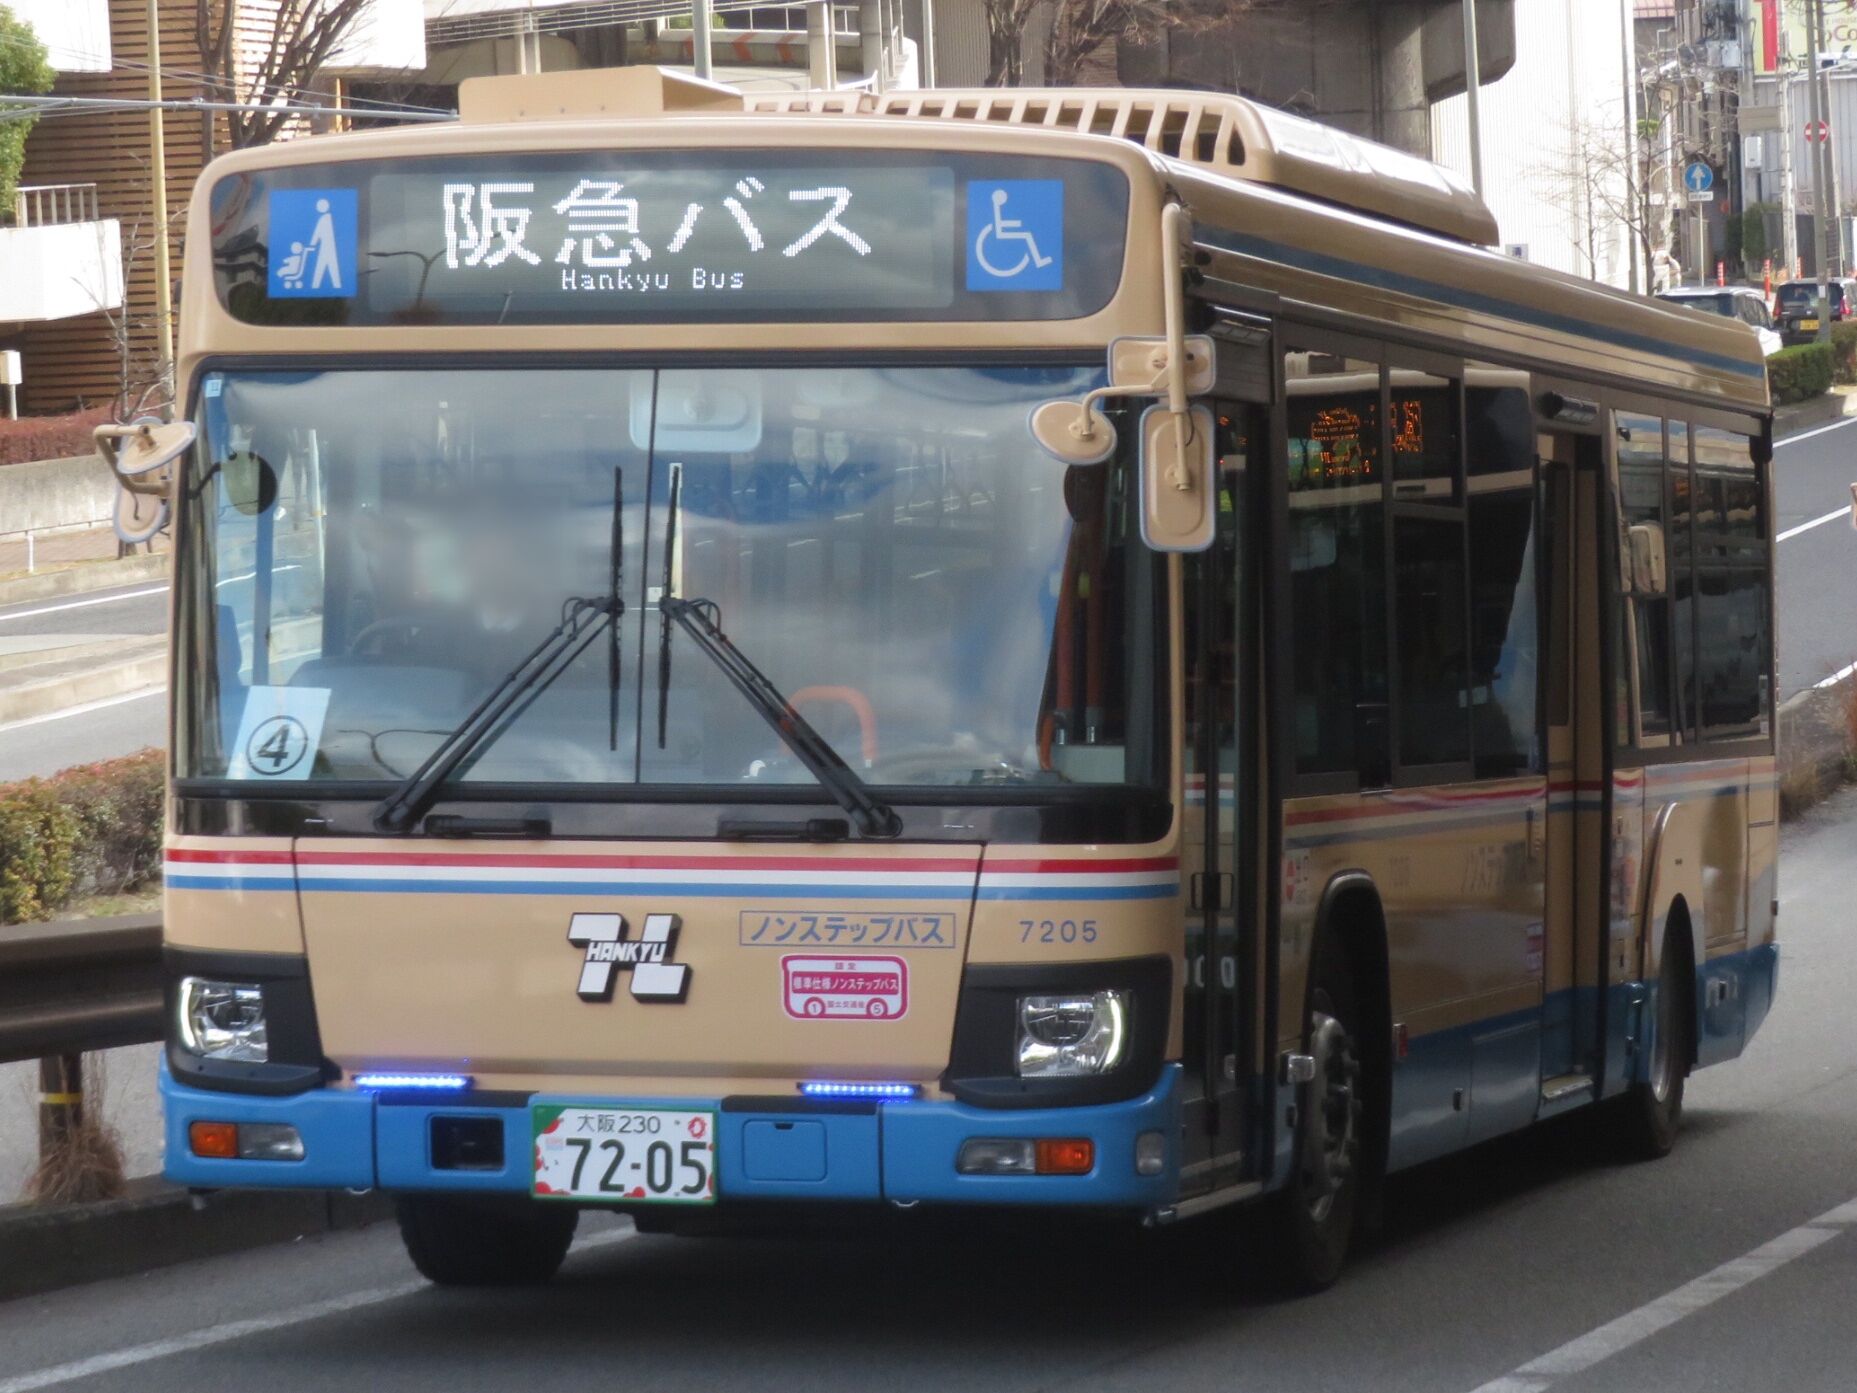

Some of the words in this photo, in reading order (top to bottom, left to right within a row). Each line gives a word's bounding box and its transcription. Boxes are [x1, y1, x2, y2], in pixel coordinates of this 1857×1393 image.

[443, 177, 872, 268] 阪急バス
[562, 269, 670, 292] Hankyu
[692, 269, 745, 291] Bus
[751, 916, 945, 943] ノンステップバス
[1019, 919, 1099, 944] 7205
[586, 941, 668, 962] HANKYU
[565, 1137, 708, 1195] 72-05
